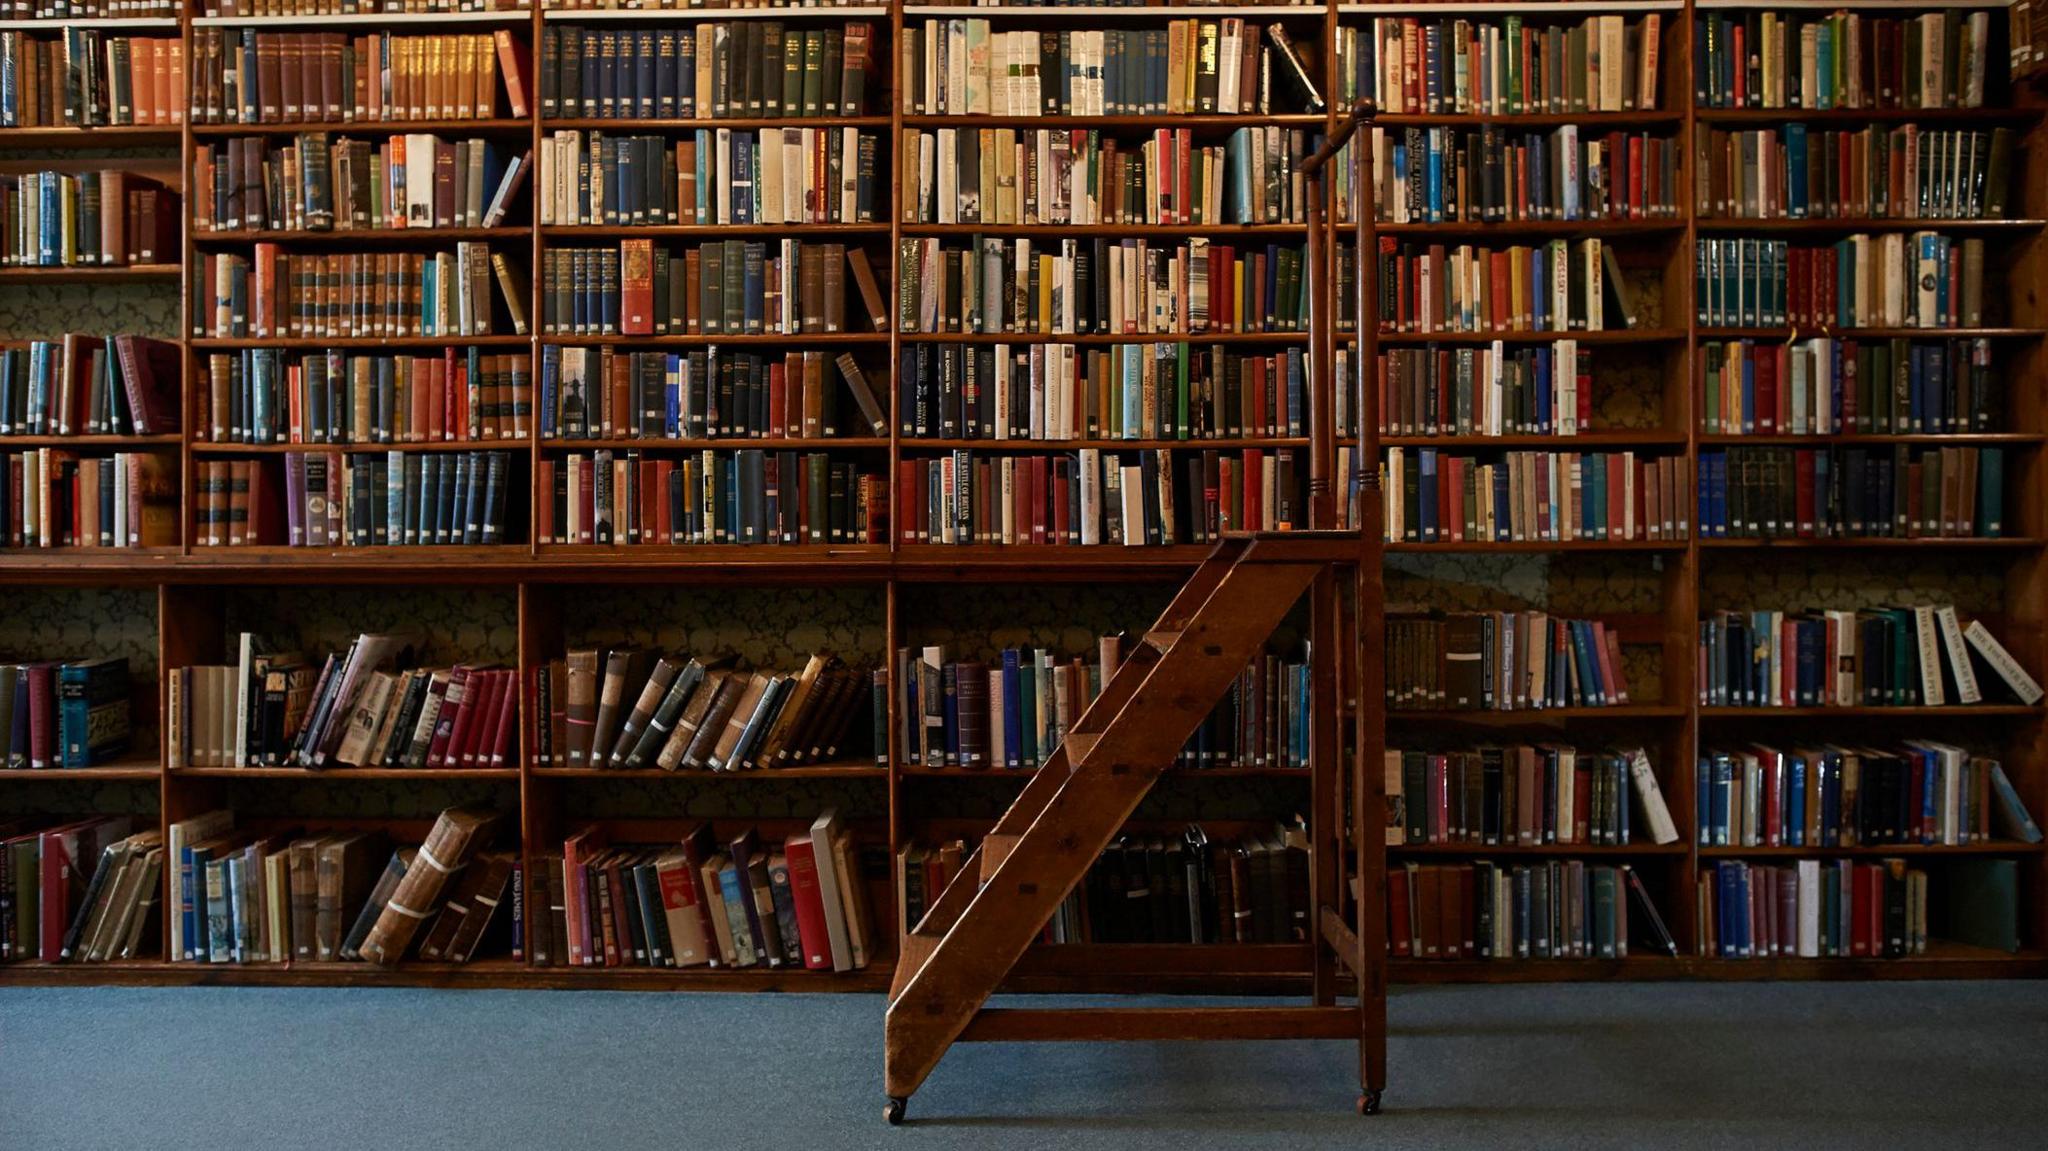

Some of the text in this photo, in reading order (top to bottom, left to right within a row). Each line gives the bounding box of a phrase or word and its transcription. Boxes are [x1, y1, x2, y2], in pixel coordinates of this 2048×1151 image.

[945, 458, 954, 494] FIGHTER
[961, 452, 969, 520] THE BATTLE OF BRITAIN
[512, 870, 523, 892] KING
[512, 892, 523, 921] JAMES
